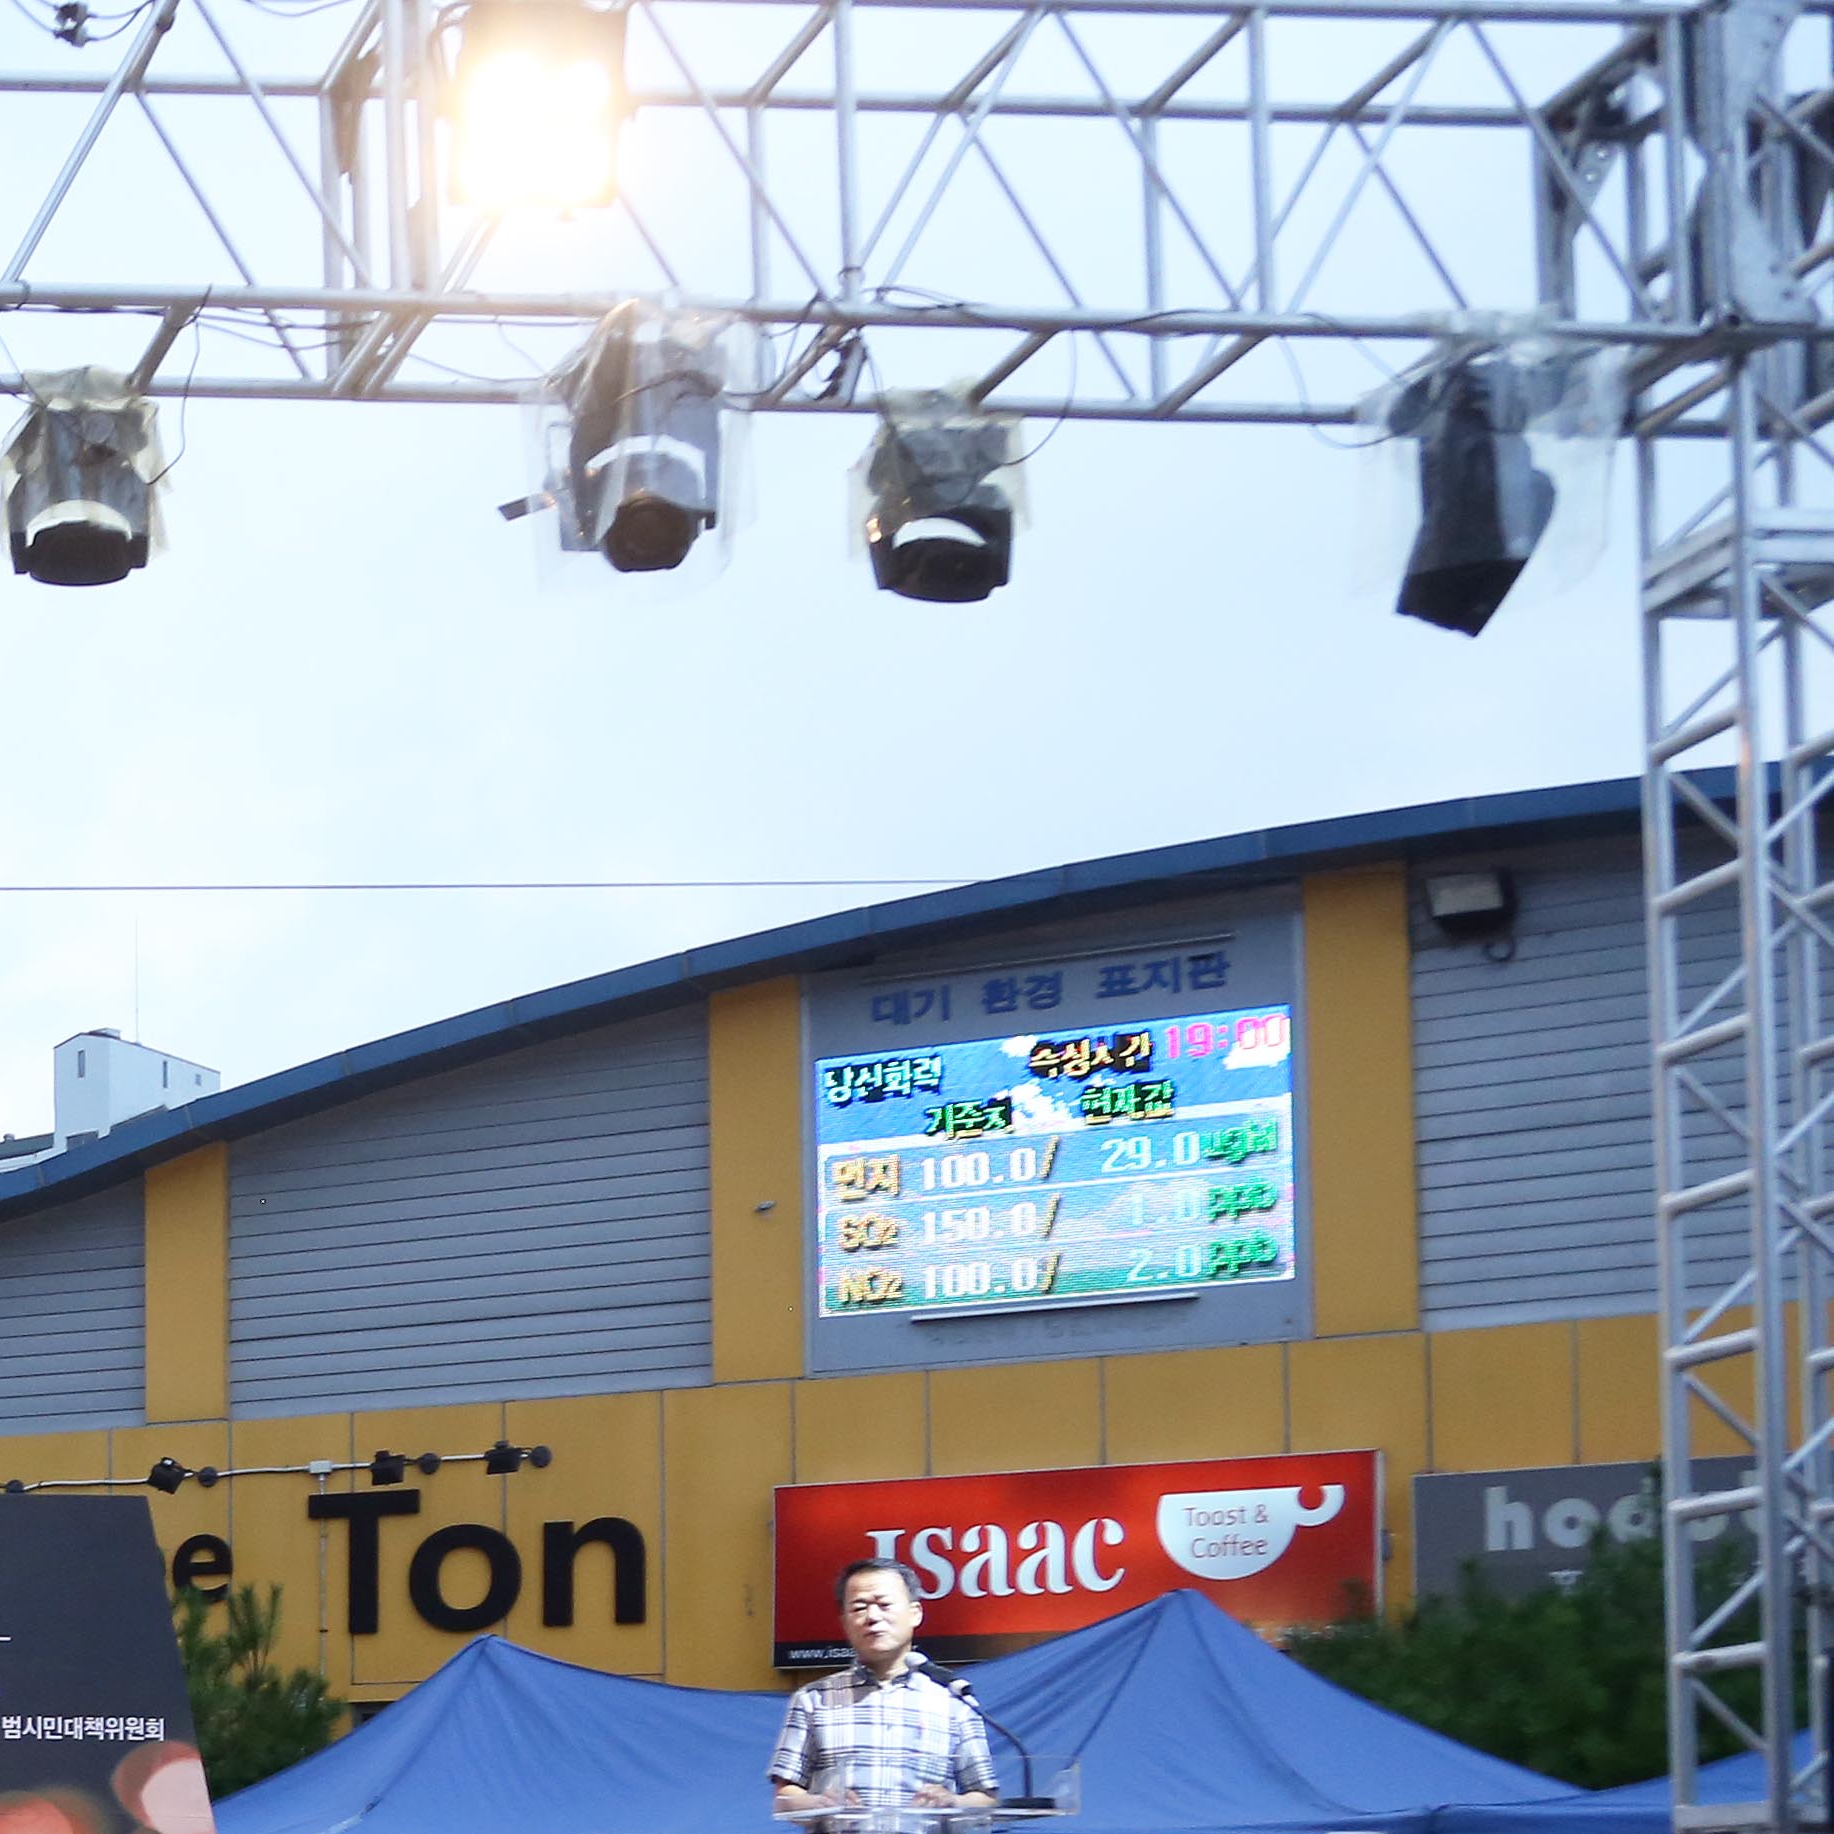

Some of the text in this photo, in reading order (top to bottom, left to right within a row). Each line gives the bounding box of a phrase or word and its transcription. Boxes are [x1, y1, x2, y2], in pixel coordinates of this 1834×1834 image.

[870, 951, 1231, 1026] 대기 환경 표지판
[1166, 1015, 1286, 1059] 19:00
[1183, 1505, 1269, 1527] Toast &
[308, 1489, 647, 1635] Ton
[1190, 1534, 1270, 1560] Coffee
[1, 1716, 165, 1742] 범시민대책위원회
